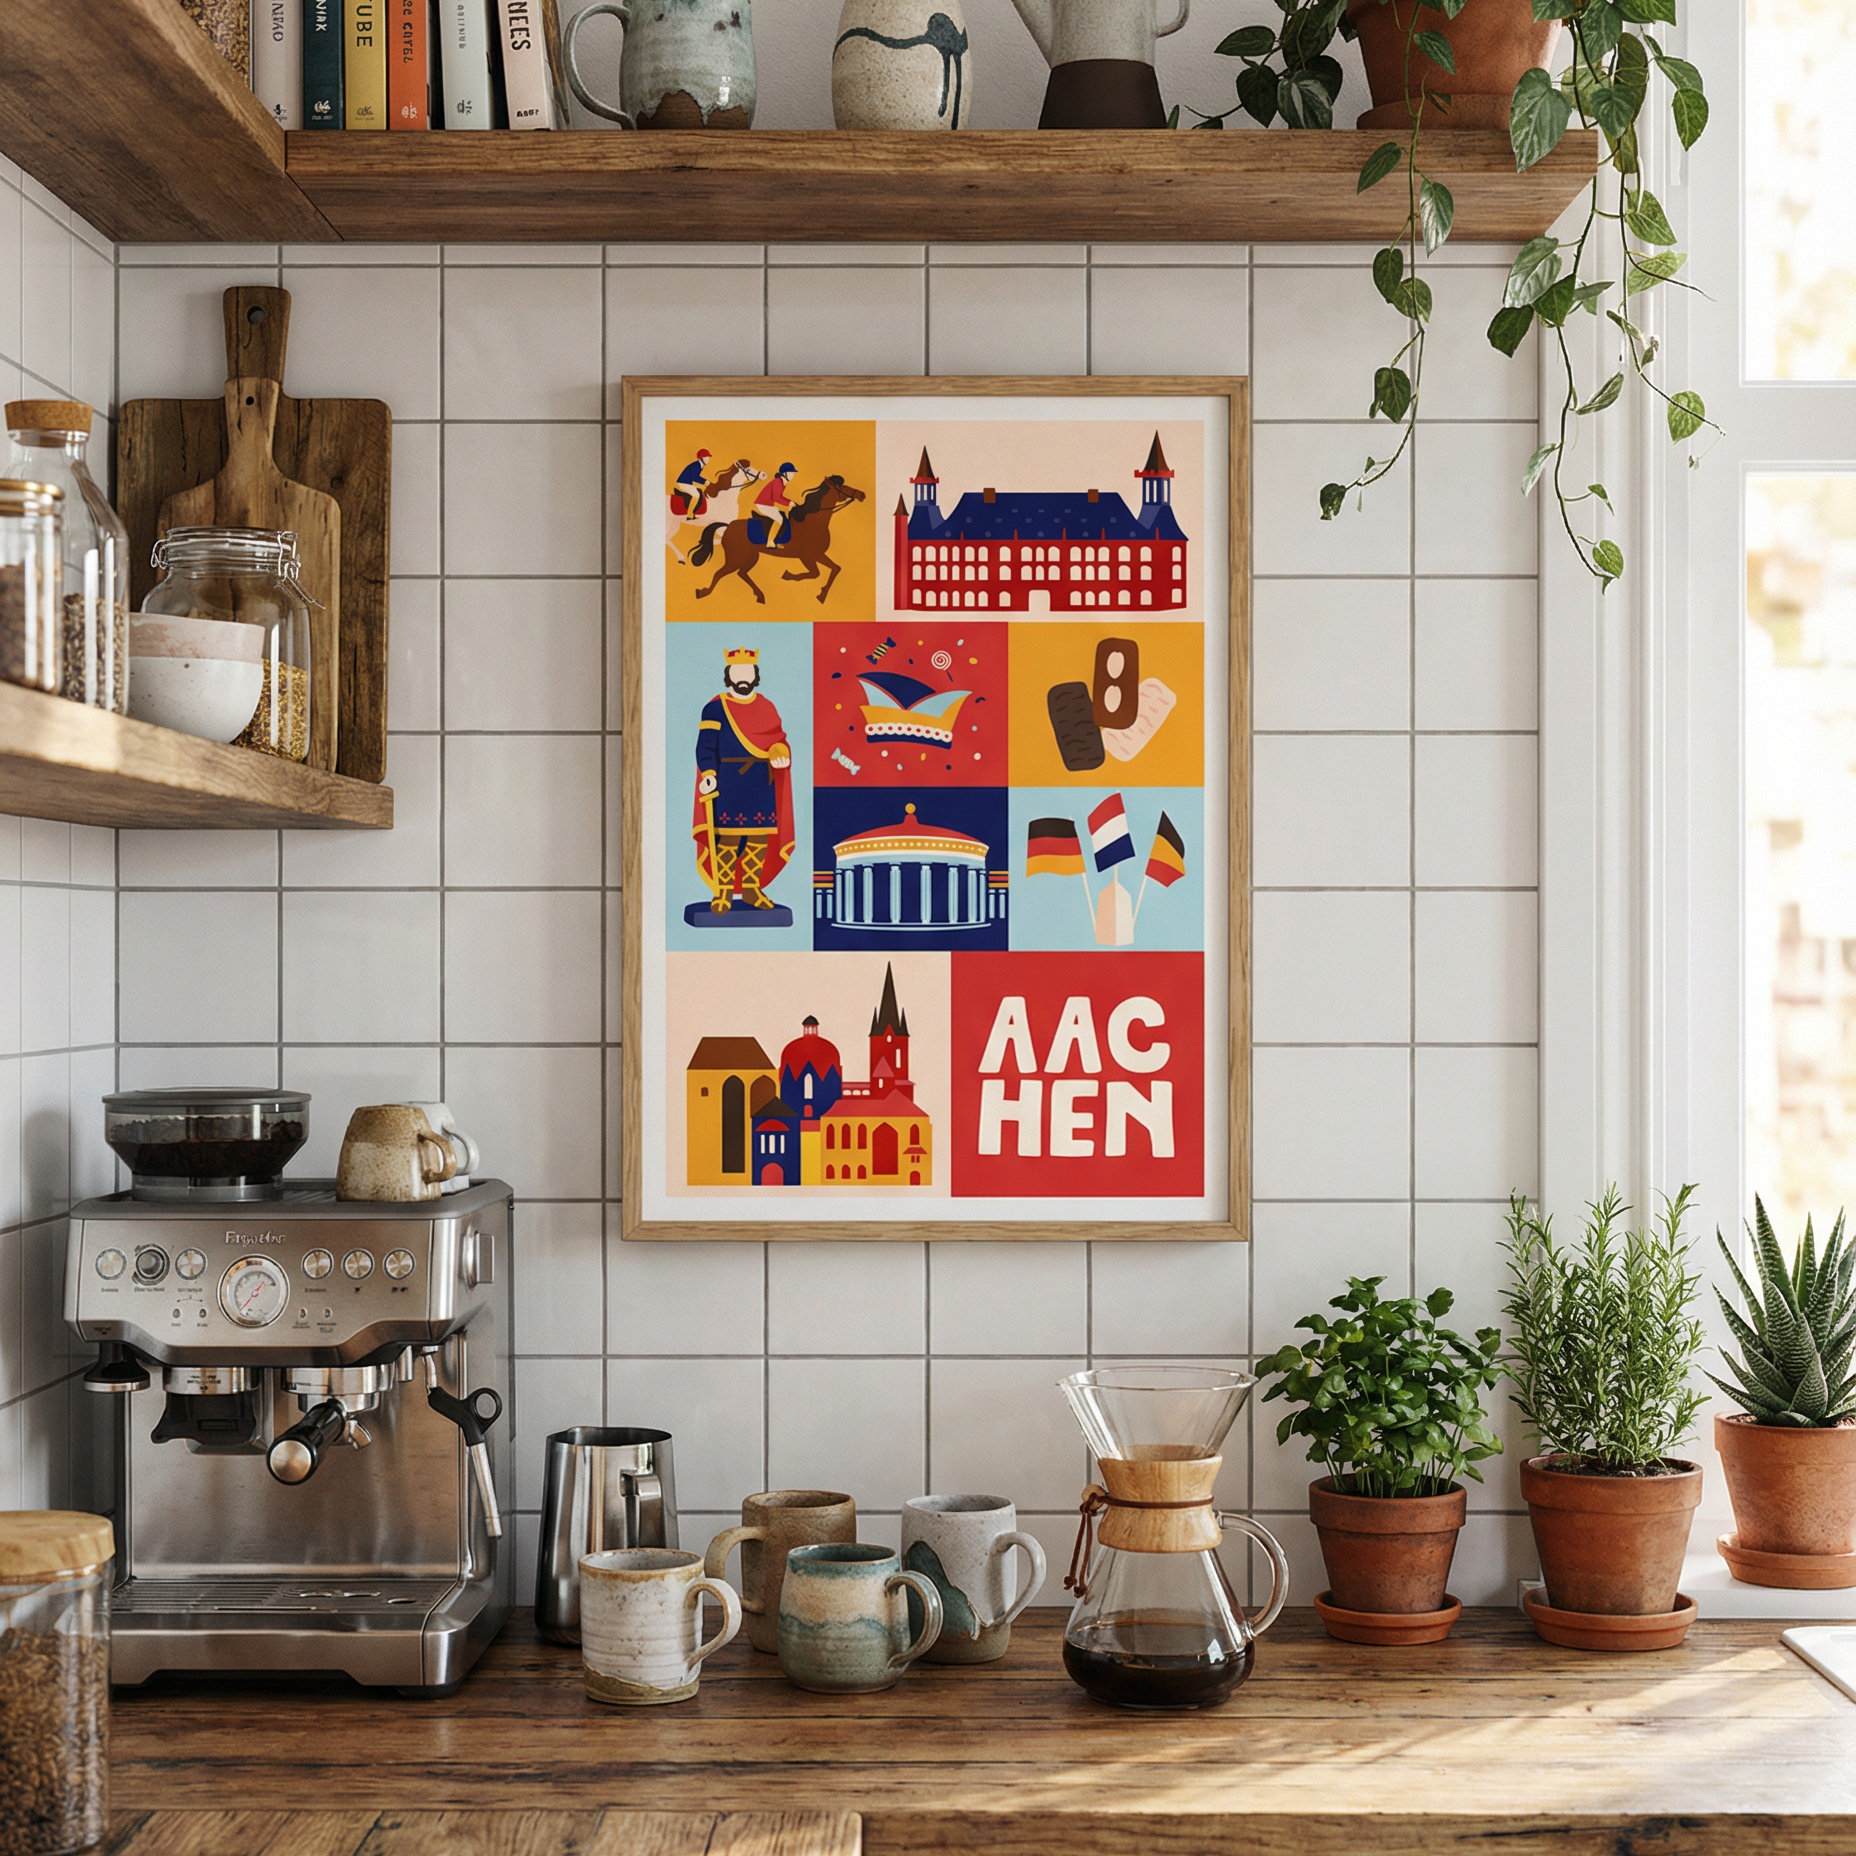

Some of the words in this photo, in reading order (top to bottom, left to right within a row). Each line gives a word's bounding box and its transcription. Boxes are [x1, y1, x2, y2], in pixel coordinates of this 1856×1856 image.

[356, 0, 373, 47] UBE
[978, 996, 1171, 1073] AAC
[978, 1079, 1175, 1157] HEN
